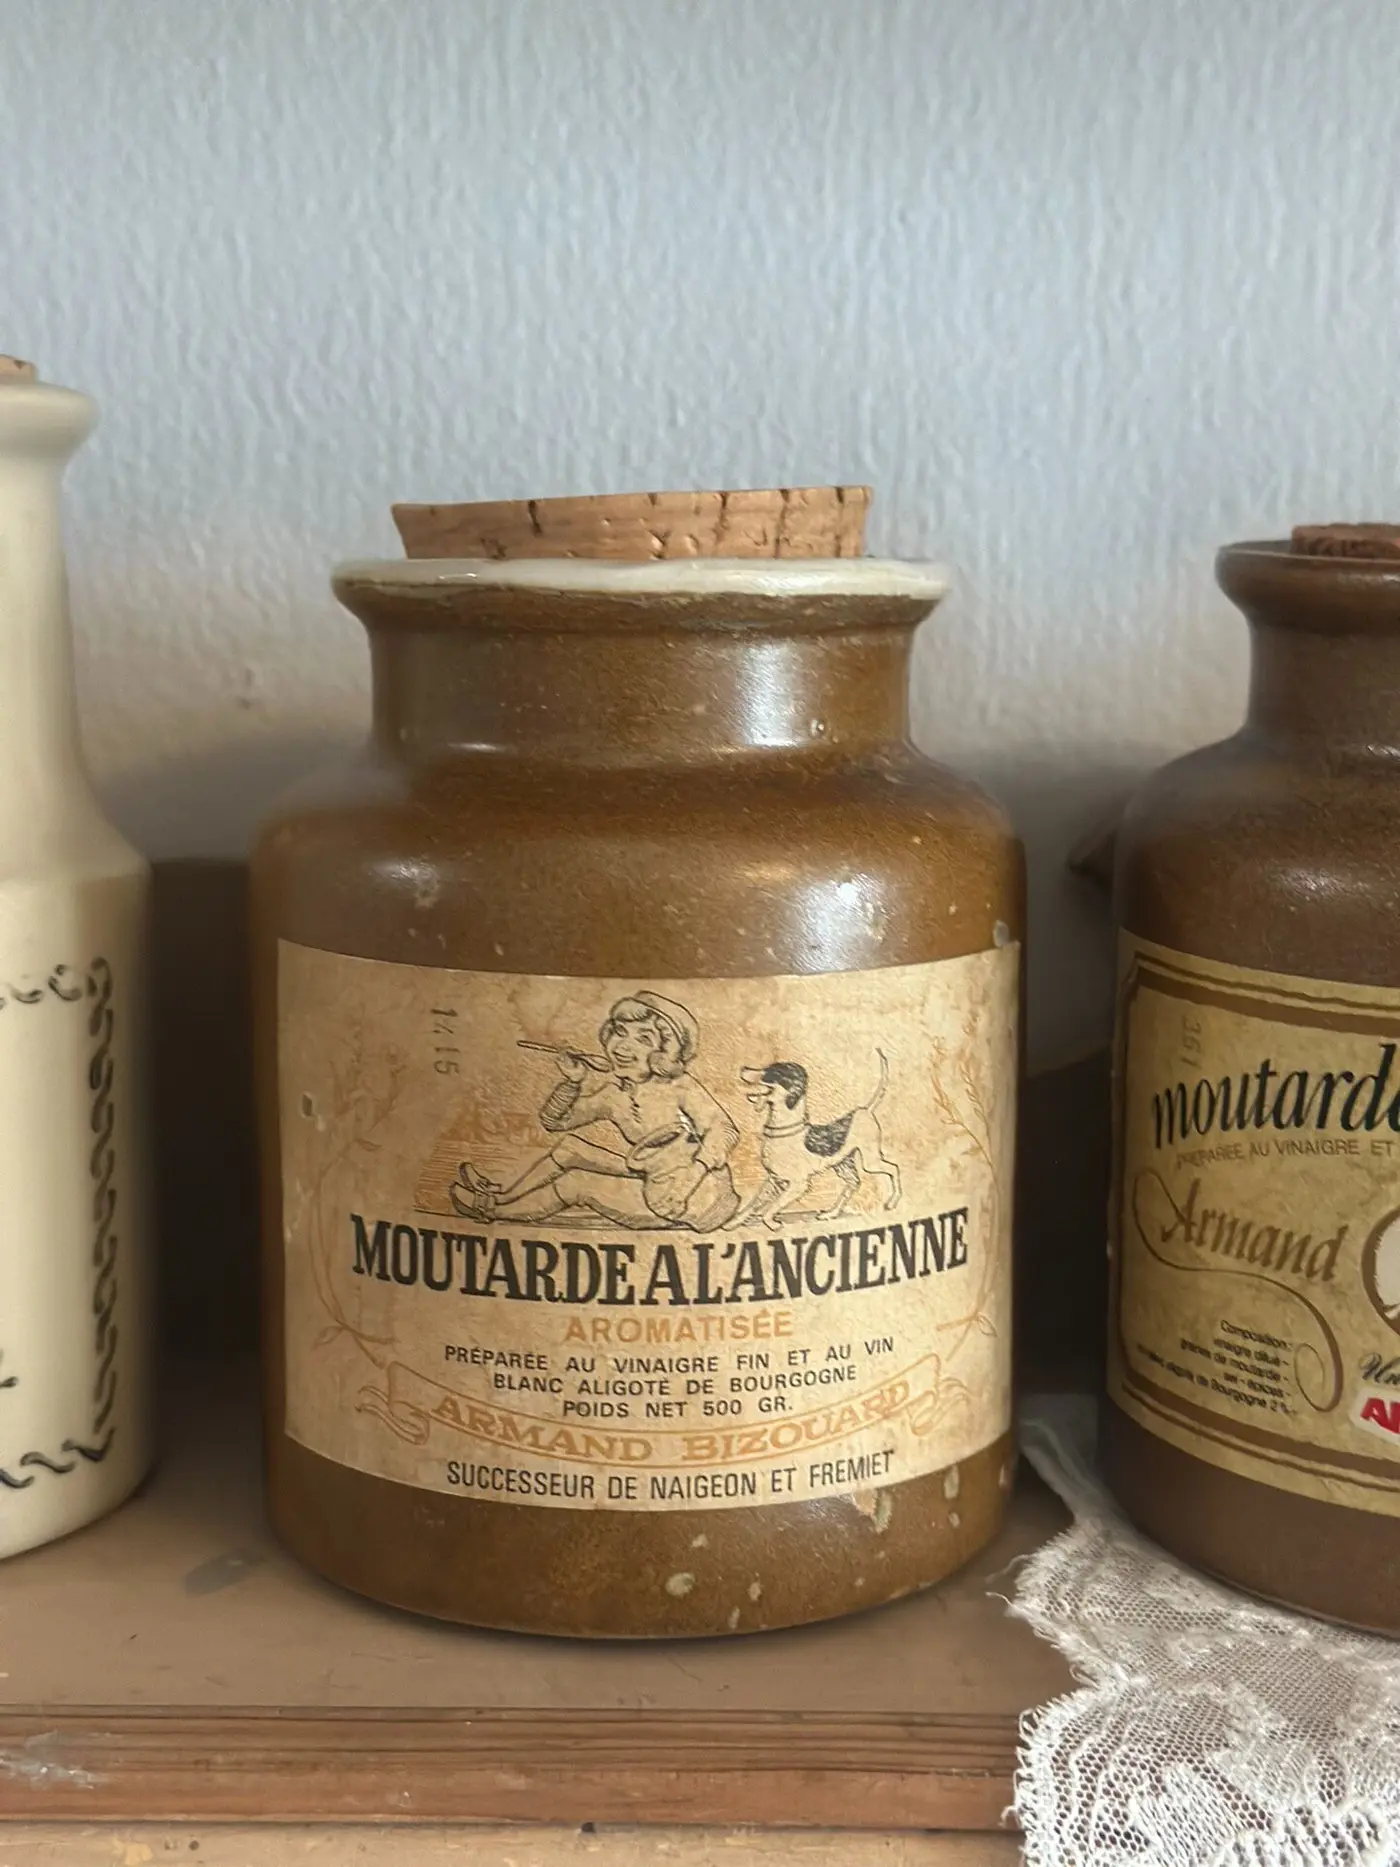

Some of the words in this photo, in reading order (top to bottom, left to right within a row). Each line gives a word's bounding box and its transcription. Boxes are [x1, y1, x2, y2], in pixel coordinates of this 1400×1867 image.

[1249, 1142, 1271, 1158] AU
[1274, 1137, 1361, 1158] VINAIGRE
[1370, 1139, 1394, 1158] ET
[1160, 1176, 1349, 1282] Armand
[350, 1212, 636, 1306] MOUTARDE
[691, 1206, 970, 1306] L'ANCIENNE
[562, 1308, 795, 1344] AROMATISÉE
[444, 1344, 549, 1371] PRÉPARÉE
[564, 1355, 596, 1374] AU
[613, 1355, 720, 1374] VINAIGRE
[736, 1352, 770, 1371] FIN
[786, 1348, 811, 1367] ET
[825, 1342, 852, 1361] AU
[863, 1336, 895, 1356] VIN
[492, 1373, 565, 1394] BLANC
[685, 1378, 714, 1396] DE
[729, 1364, 857, 1394] BOURGOGNE
[431, 1394, 653, 1462] ARMAND
[680, 1379, 910, 1461] BIZOUARD
[562, 1399, 631, 1419] POIDS
[645, 1400, 689, 1419] NET
[702, 1399, 743, 1417] 500
[758, 1395, 794, 1414] GR.
[446, 1460, 595, 1500] SUCCESSEUR
[607, 1476, 638, 1500] DE
[650, 1472, 757, 1500] NAIGEON
[771, 1467, 798, 1493] ET
[809, 1449, 895, 1489] FREMIET
